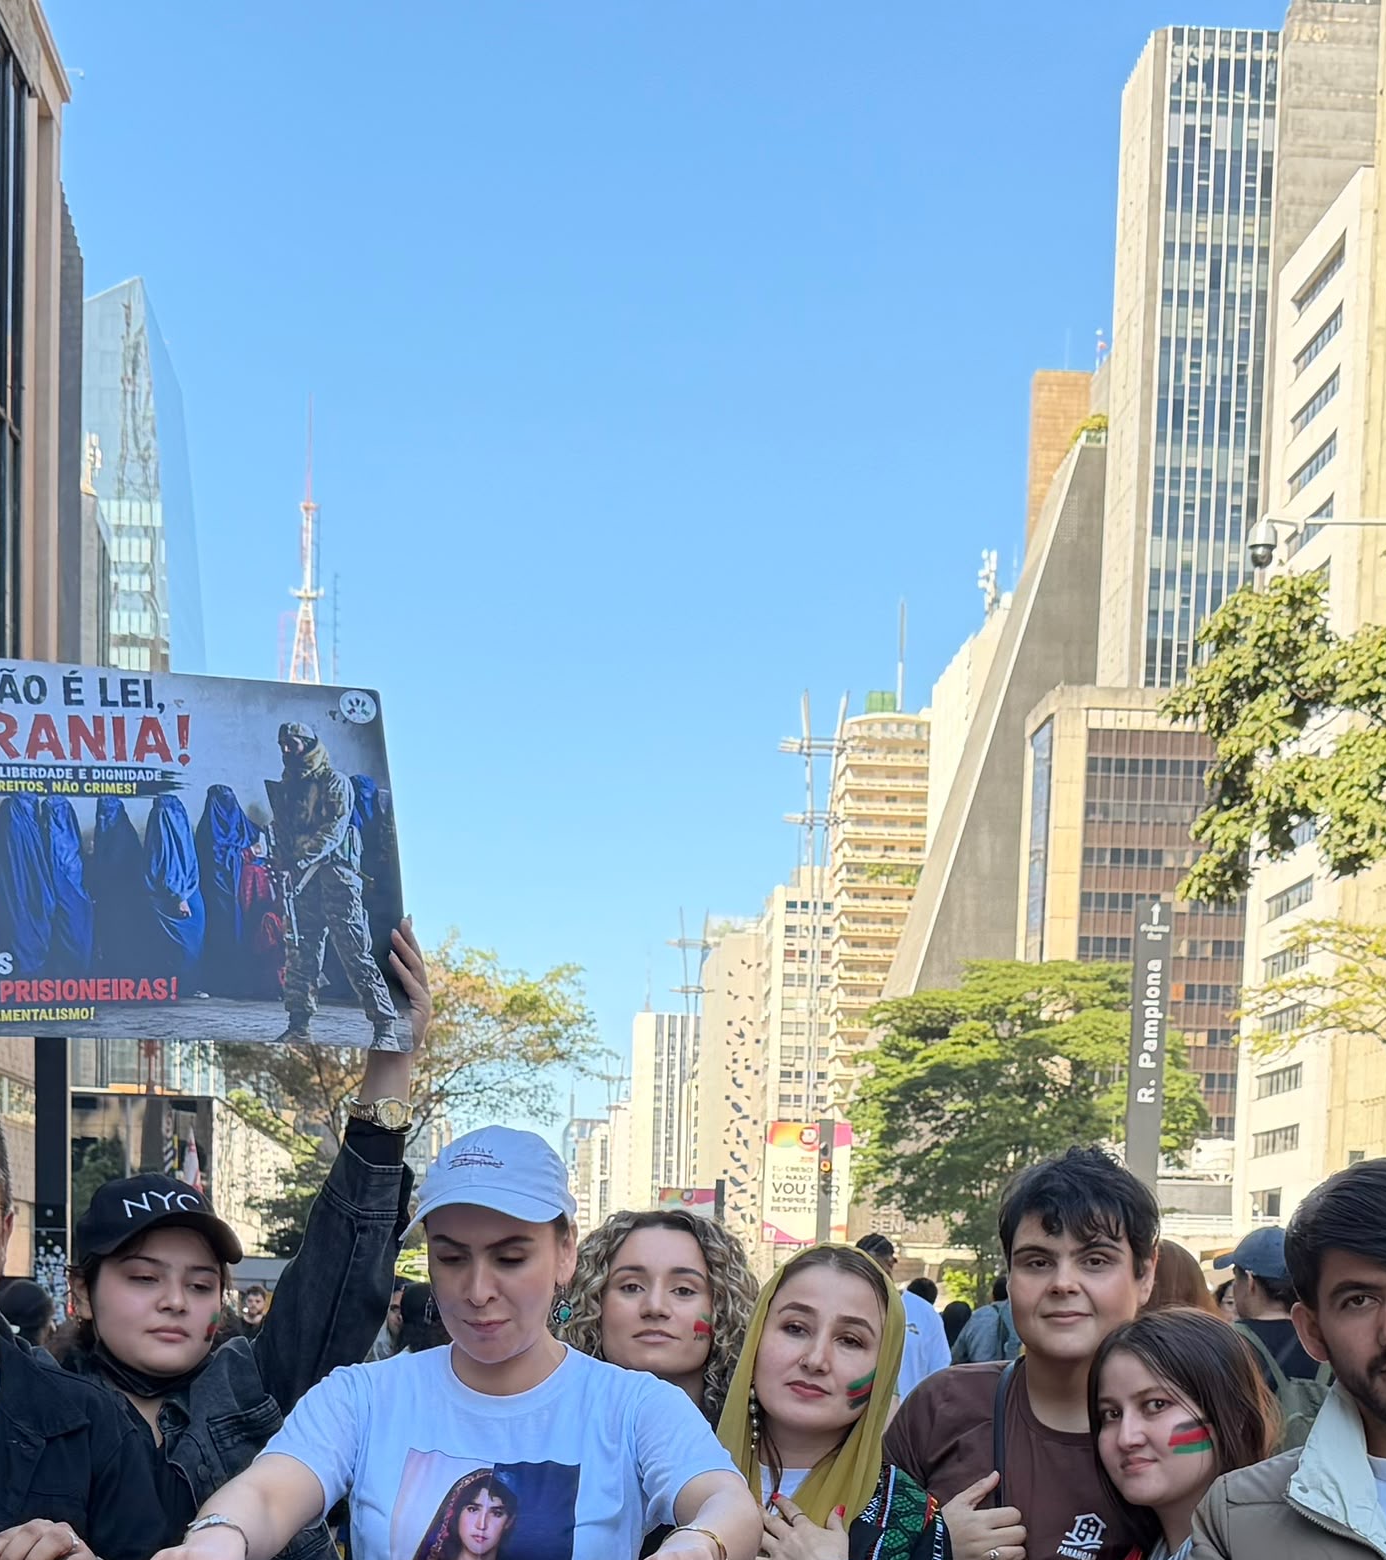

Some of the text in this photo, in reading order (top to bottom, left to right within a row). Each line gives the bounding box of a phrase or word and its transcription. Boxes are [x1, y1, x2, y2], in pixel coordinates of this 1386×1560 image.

[63, 670, 84, 706] É
[99, 677, 165, 714] LEI,
[0, 766, 72, 780] LIBERDADE
[79, 768, 87, 781] E
[92, 768, 162, 782] DIGNIDADE
[52, 780, 79, 795] NÃO
[84, 782, 137, 795] CRIMES!
[0, 976, 178, 1003] PRISIONEIRAS!
[1138, 958, 1164, 1068] Pamplona
[1137, 1079, 1156, 1104] R.
[772, 1182, 807, 1195] VOU
[122, 1191, 199, 1218] NYC
